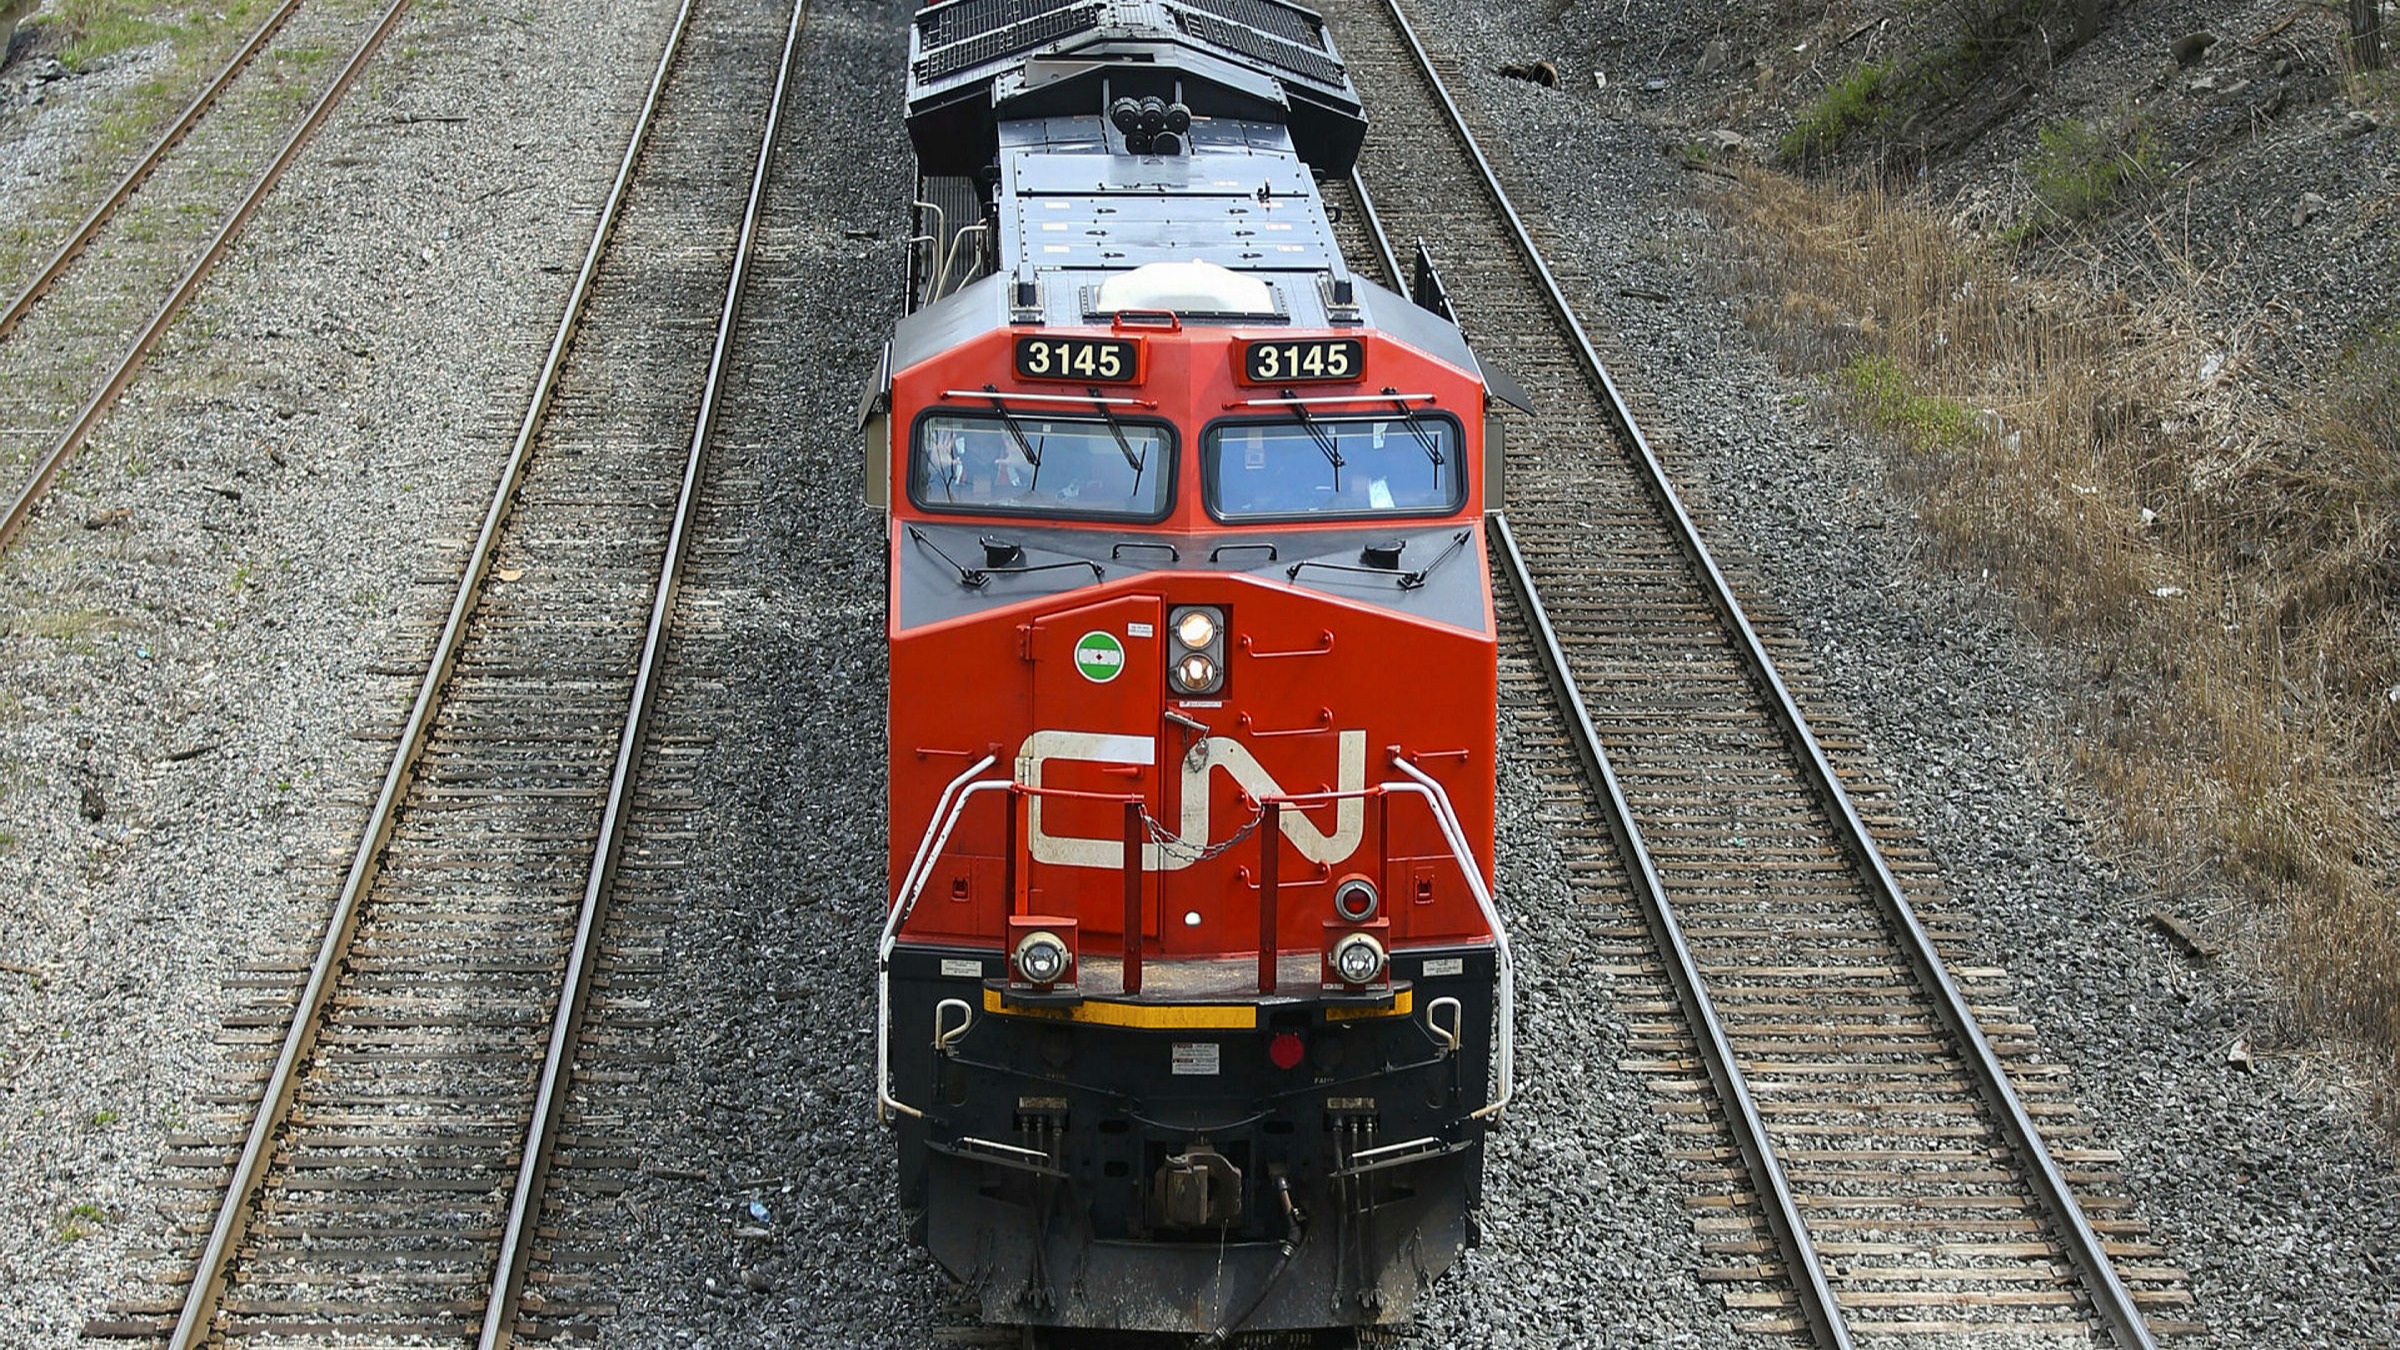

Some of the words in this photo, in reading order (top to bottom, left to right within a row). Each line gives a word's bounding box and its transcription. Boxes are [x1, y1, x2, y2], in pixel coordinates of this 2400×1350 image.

[1028, 342, 1121, 378] 3145
[1257, 344, 1349, 378] 3145
[1015, 729, 1367, 872] CN
